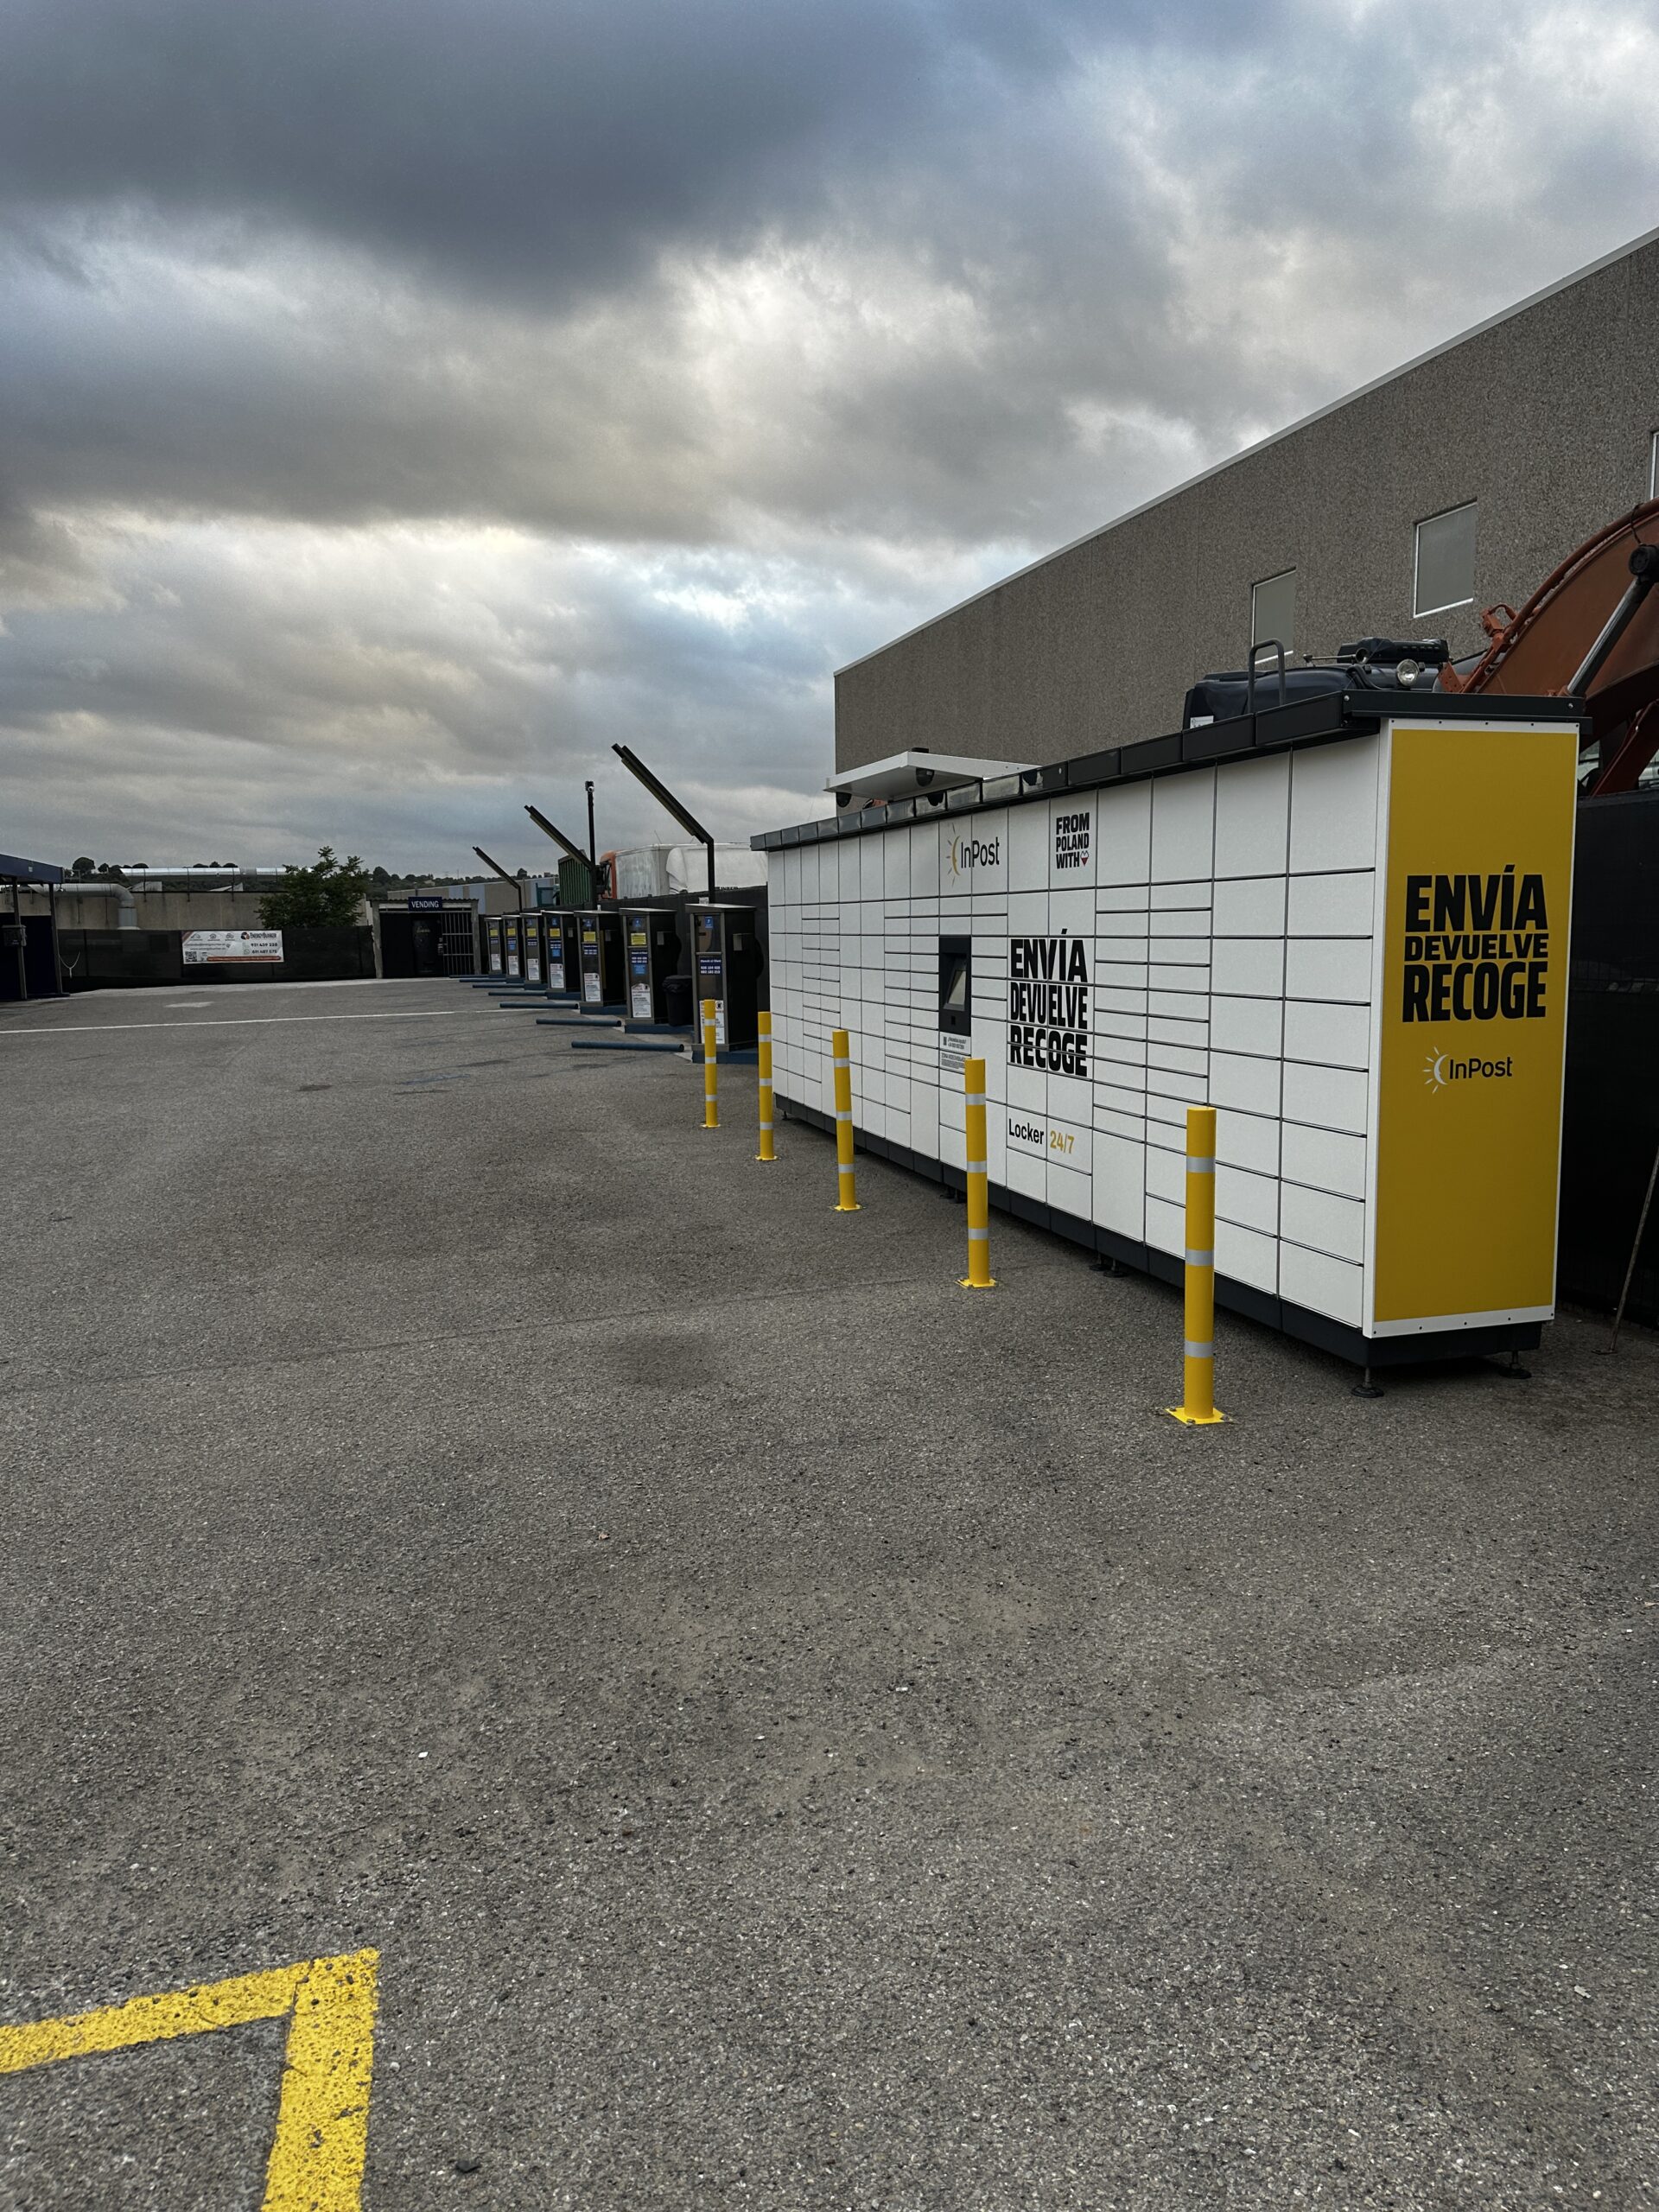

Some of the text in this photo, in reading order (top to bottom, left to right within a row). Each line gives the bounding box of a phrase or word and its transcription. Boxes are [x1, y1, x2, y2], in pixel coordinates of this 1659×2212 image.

[1056, 812, 1090, 835] FROM
[961, 836, 1000, 868] InPost
[1056, 833, 1090, 852] POLAND
[1056, 852, 1080, 869] WITH
[1404, 864, 1548, 932] ENVÍA
[1011, 928, 1087, 983] ENVÍA
[1404, 933, 1548, 961] DEVUELVE
[1010, 982, 1087, 1030] DEVUELVE
[1402, 962, 1548, 1022] RECOGE
[1010, 1025, 1087, 1077] RECOGE
[1449, 1056, 1513, 1080] InPost
[1008, 1118, 1074, 1154] Locker 24/7
